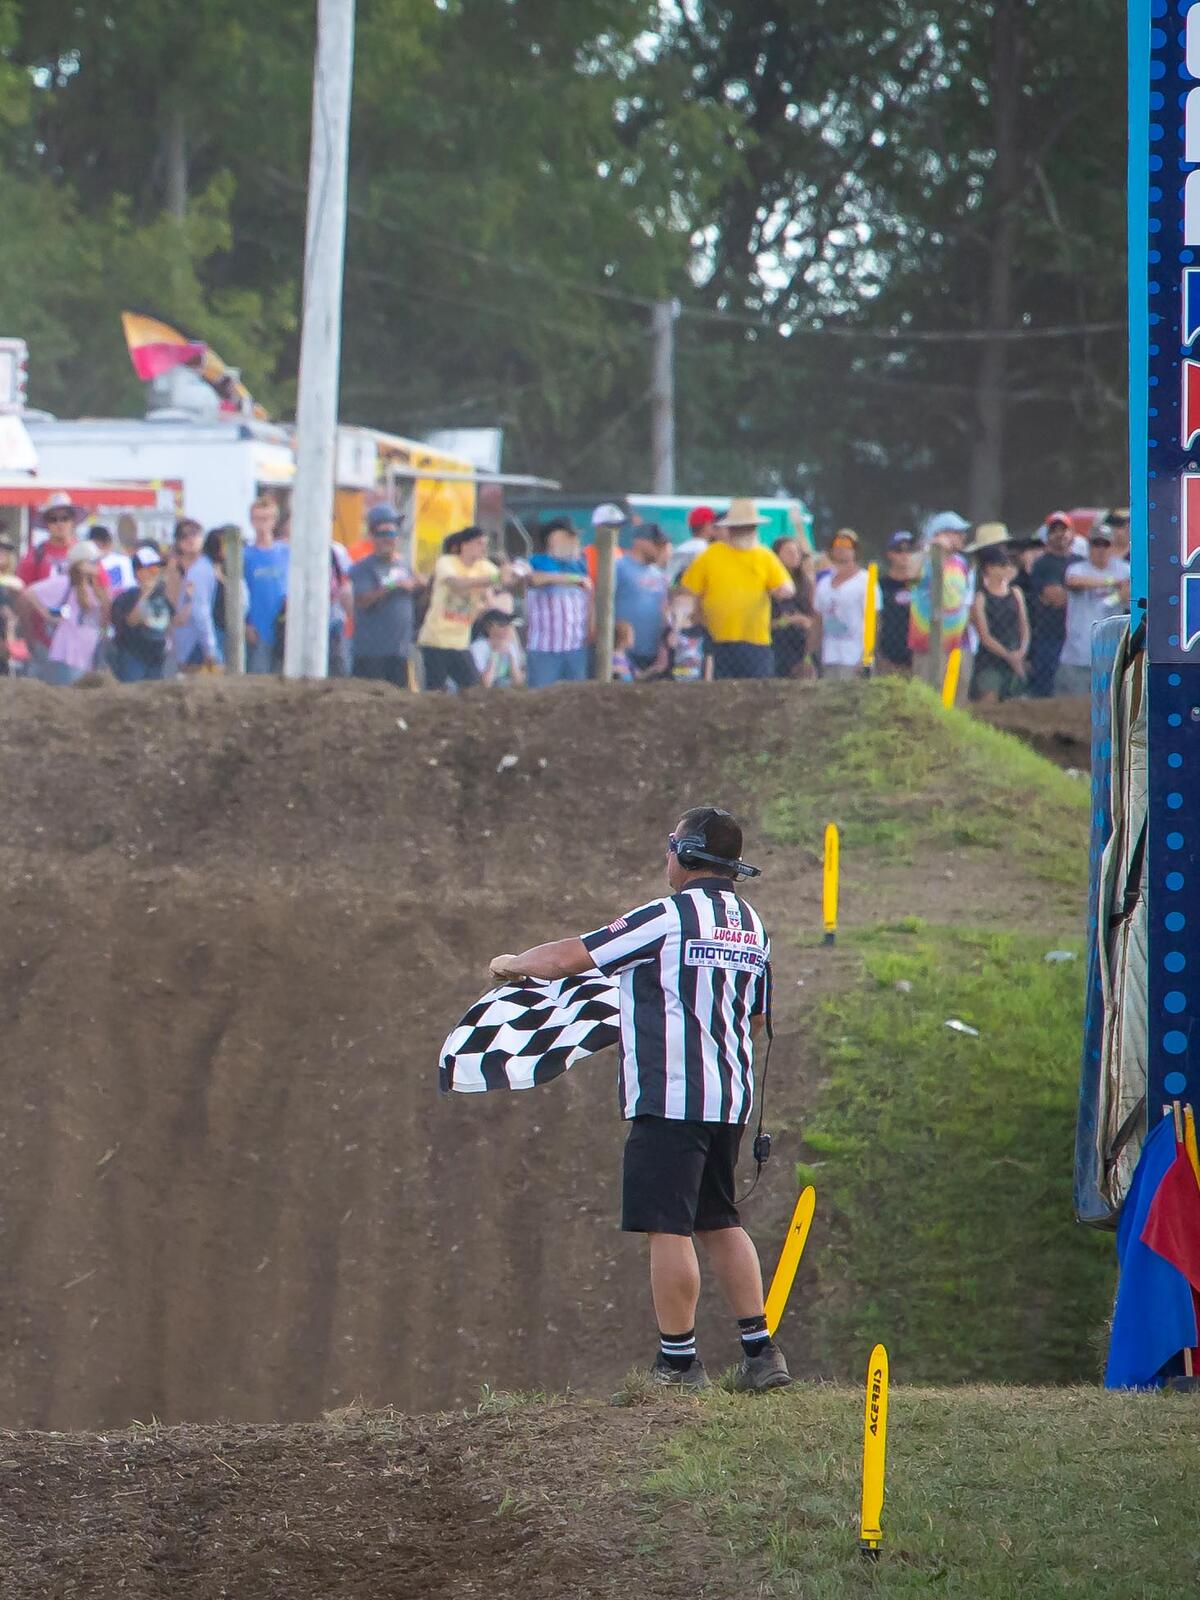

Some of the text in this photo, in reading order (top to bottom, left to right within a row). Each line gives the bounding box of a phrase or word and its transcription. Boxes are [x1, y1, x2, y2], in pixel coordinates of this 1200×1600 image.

[713, 929, 757, 945] LUCAS OIL
[869, 1368, 882, 1437] ACERBIS
